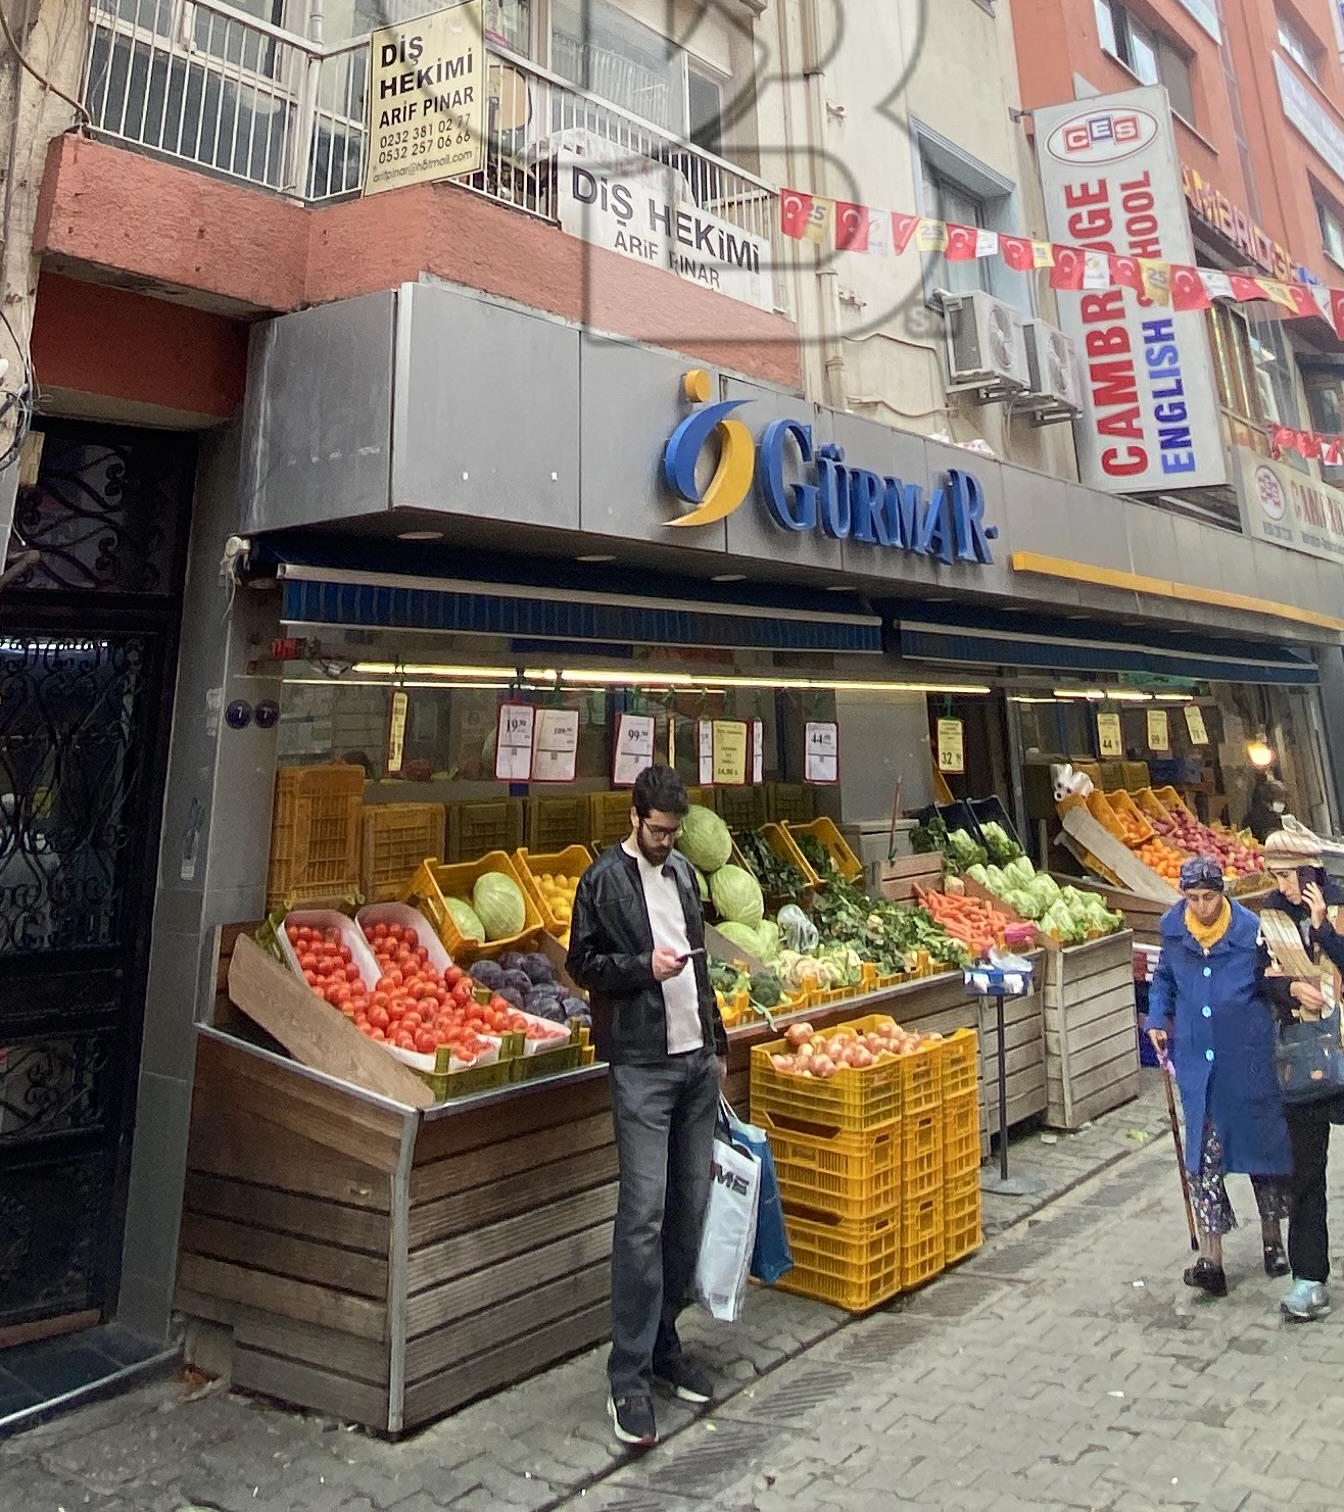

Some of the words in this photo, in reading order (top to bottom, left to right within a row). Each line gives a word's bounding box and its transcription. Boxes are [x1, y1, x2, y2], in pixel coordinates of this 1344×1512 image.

[381, 34, 424, 68] DİŞ
[380, 47, 473, 100] HEKİMİ
[379, 100, 418, 129] ARİF
[423, 86, 474, 117] PINAR
[378, 146, 408, 165] 0532
[411, 139, 433, 157] 257
[437, 135, 452, 149] 06
[380, 130, 409, 149] 0232
[413, 122, 433, 140] 381
[438, 117, 453, 133] 02
[1063, 111, 1140, 154] CES
[570, 163, 634, 227] DİŞ
[649, 197, 762, 276] HEKİMİ
[613, 228, 660, 262] ARİF
[1146, 266, 1168, 288] 25
[1065, 177, 1150, 477] CAMBRGE
[1141, 317, 1196, 475] ENGLISH
